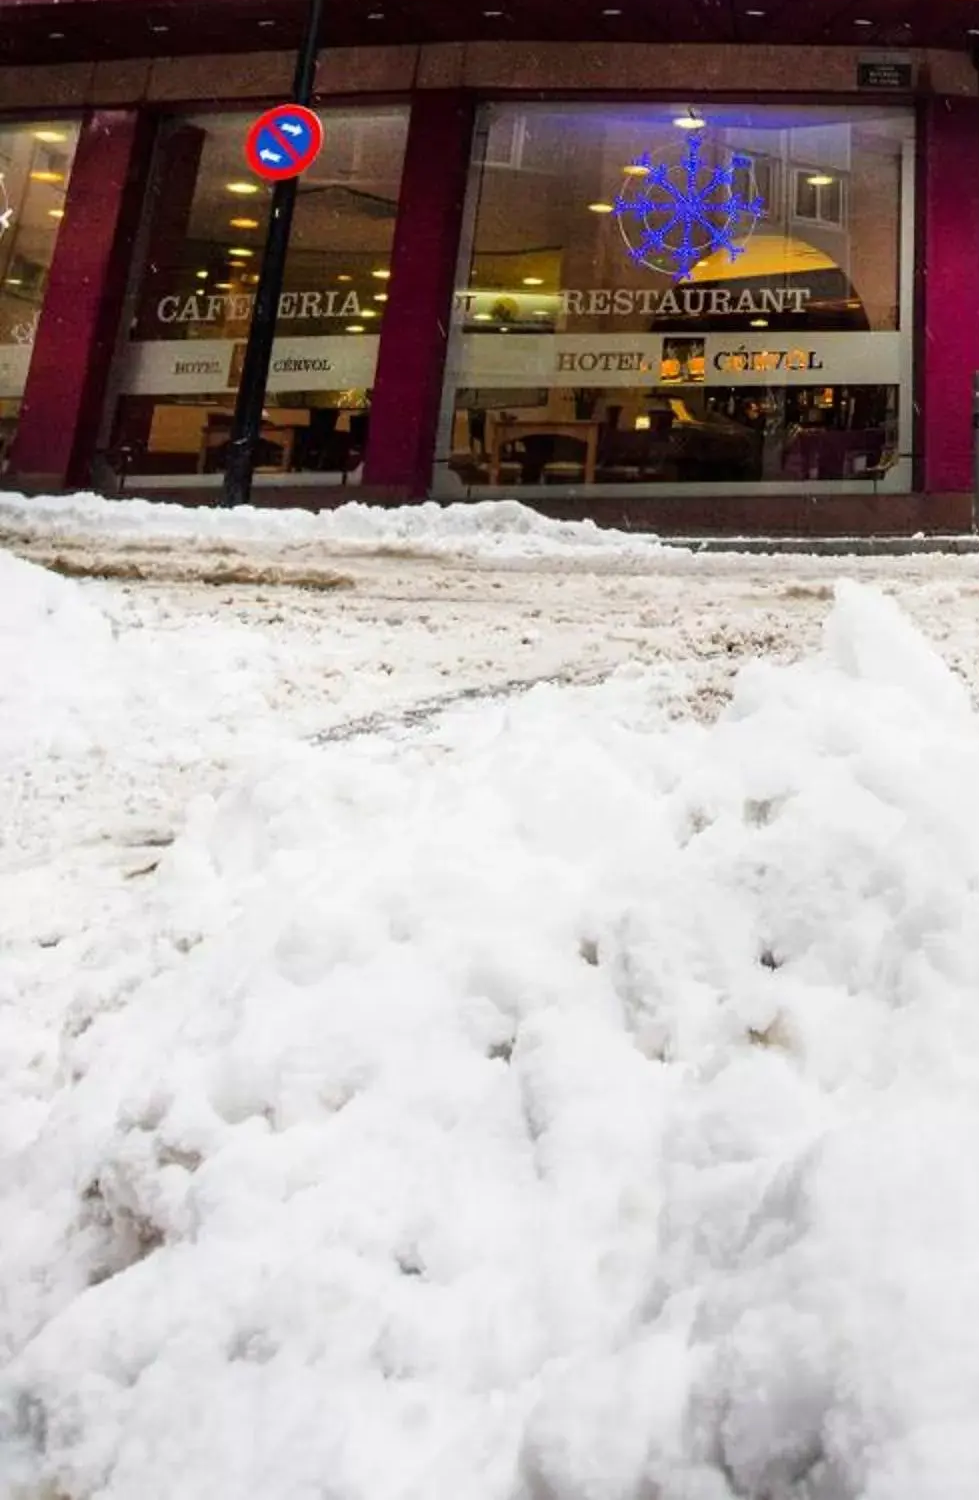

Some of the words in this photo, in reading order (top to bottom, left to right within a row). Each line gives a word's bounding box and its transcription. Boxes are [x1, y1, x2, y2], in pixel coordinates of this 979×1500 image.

[157, 291, 364, 323] CAFEERIA
[561, 288, 811, 316] RESTAURANT
[174, 360, 222, 375] HOTEL
[556, 352, 653, 373] HOTEL
